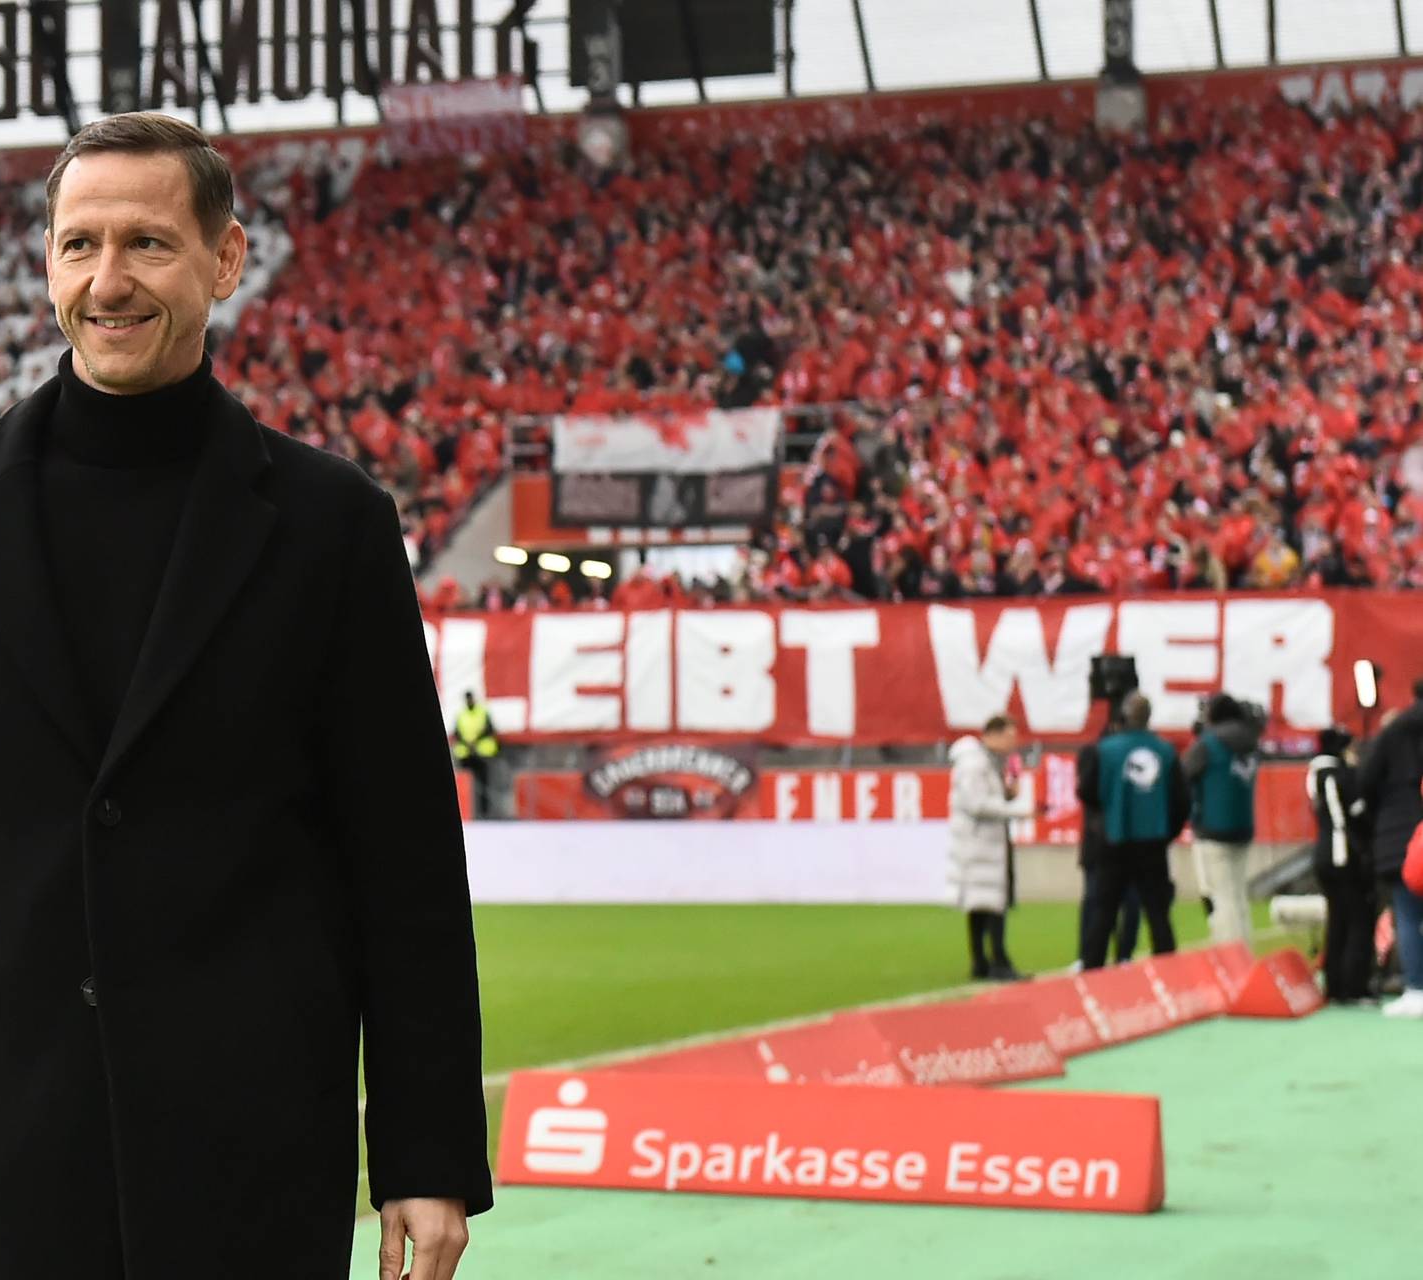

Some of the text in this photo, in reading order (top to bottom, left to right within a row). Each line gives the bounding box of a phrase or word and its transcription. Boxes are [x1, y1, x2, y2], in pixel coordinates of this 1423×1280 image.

[423, 599, 1335, 738] LEIBT WER
[629, 1129, 928, 1190] Sparkasse
[944, 1141, 1120, 1200] Essen
